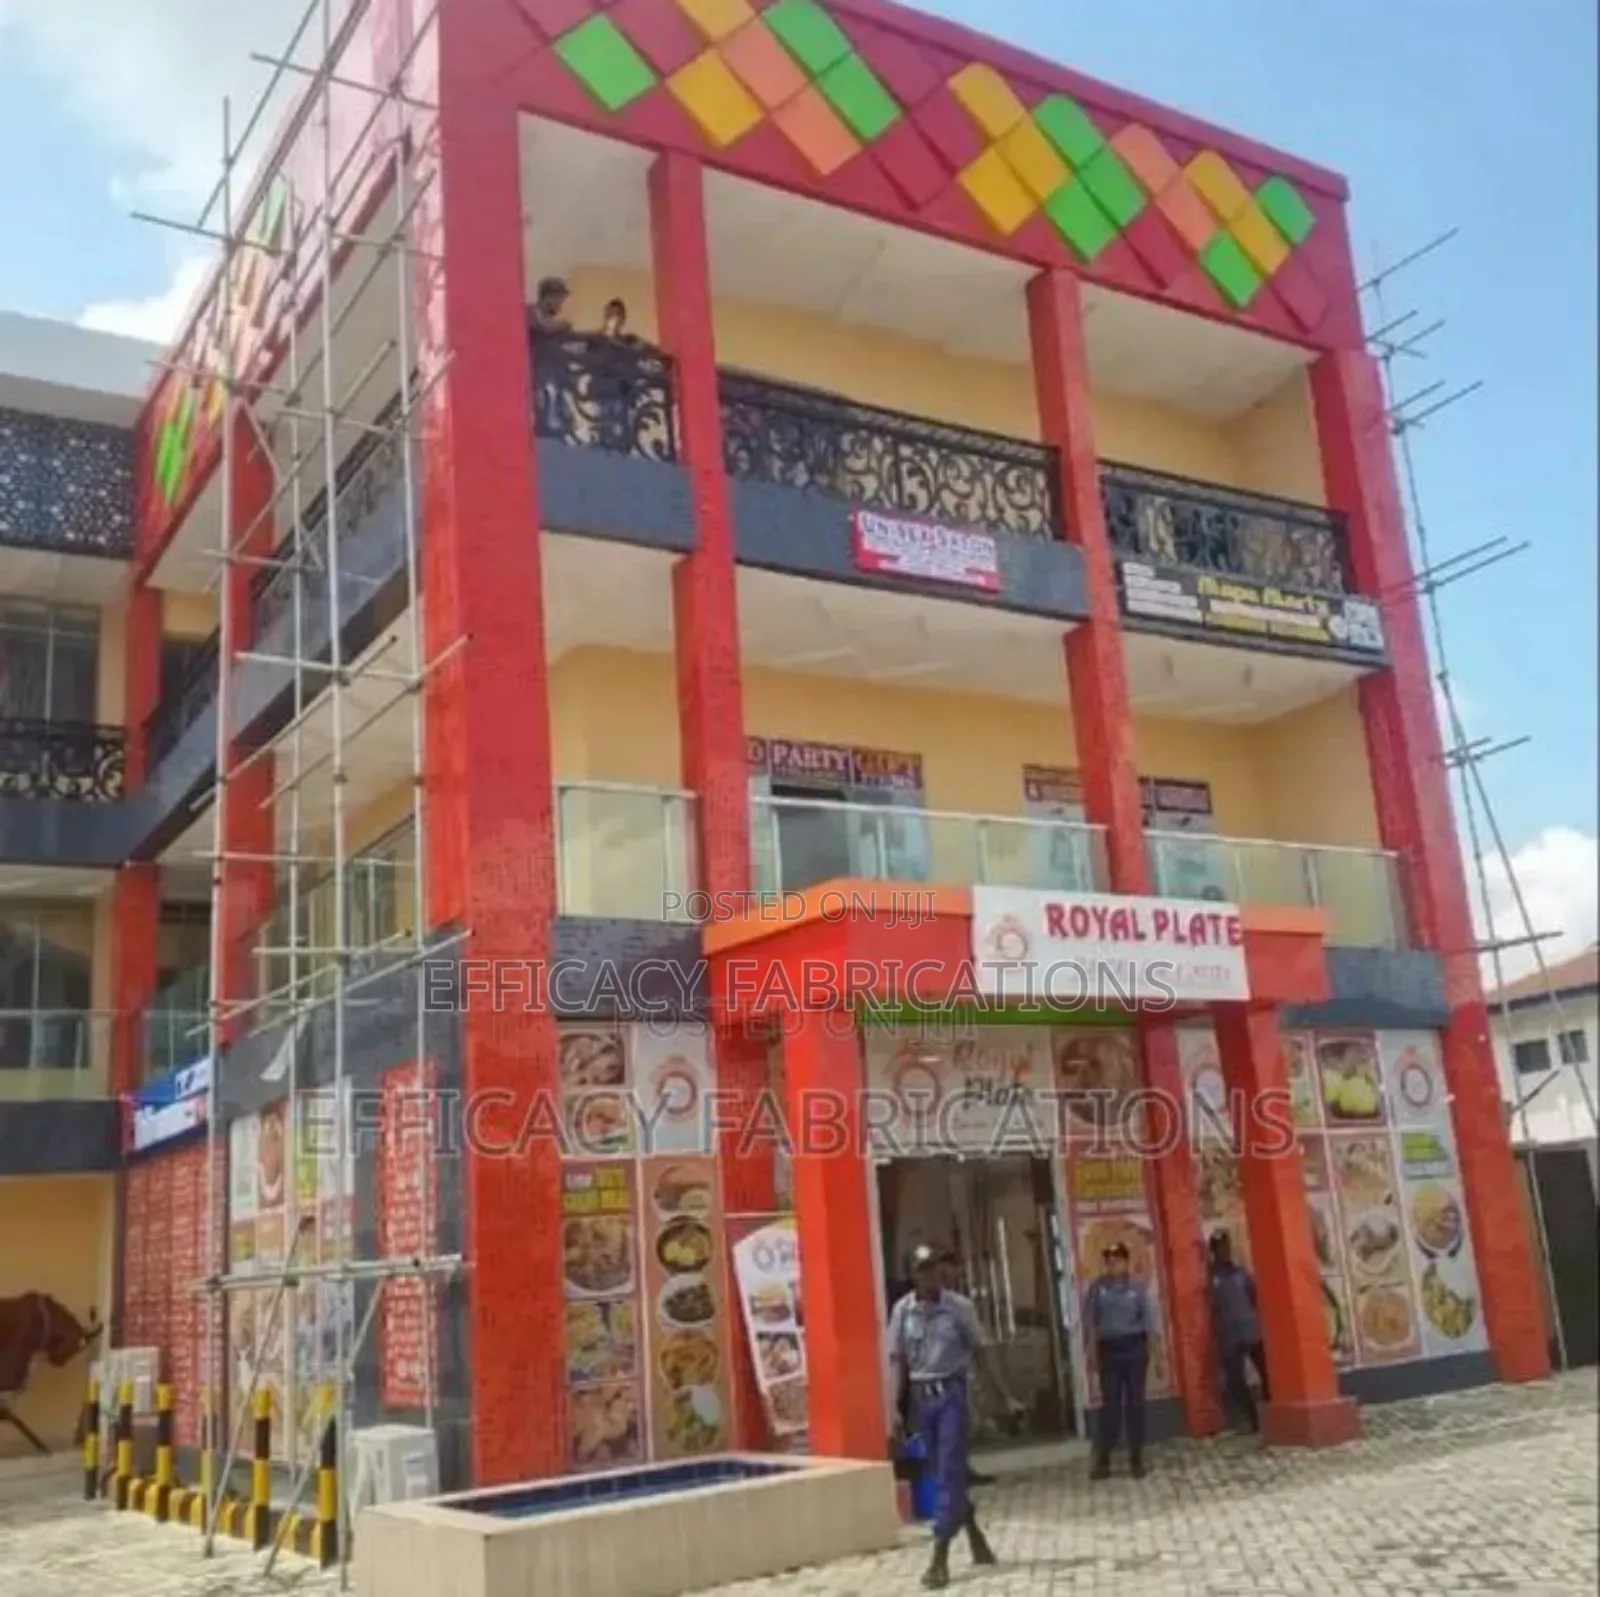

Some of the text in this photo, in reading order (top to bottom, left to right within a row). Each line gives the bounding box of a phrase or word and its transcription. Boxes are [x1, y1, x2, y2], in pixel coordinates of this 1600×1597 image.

[773, 742, 847, 771] PARTY
[1045, 903, 1242, 948] ROYAL PLATE
